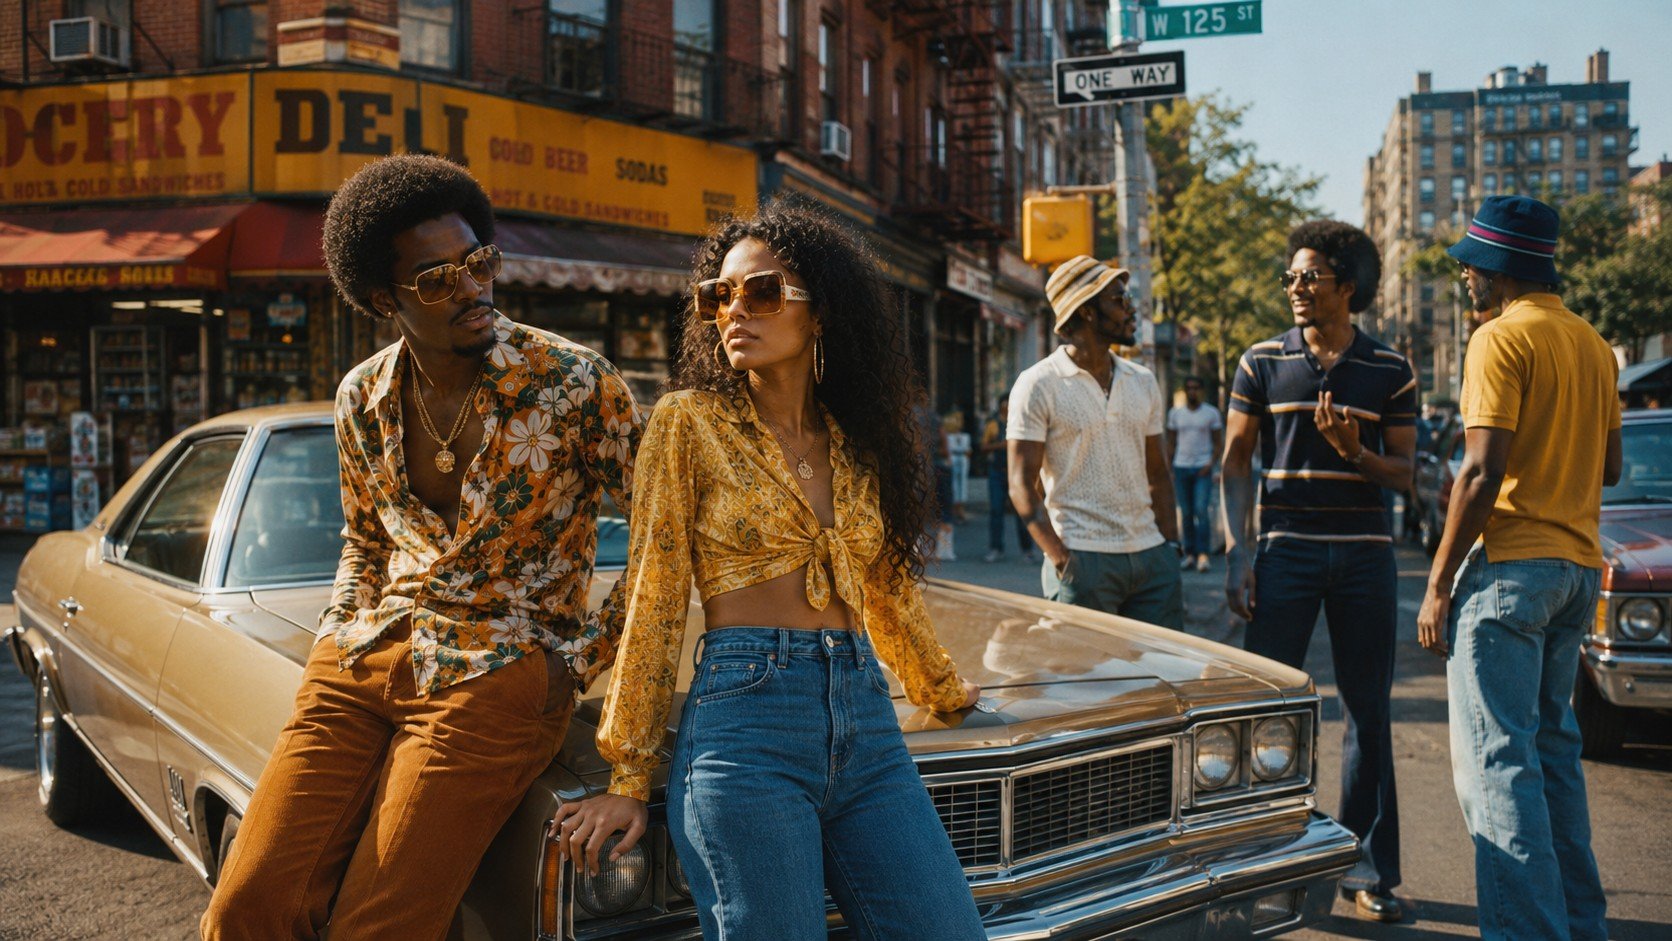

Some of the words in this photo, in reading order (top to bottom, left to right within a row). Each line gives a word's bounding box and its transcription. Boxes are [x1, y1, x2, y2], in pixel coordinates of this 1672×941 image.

[1152, 14, 1168, 36] W
[1182, 7, 1226, 34] 125
[1237, 5, 1254, 21] ST
[1075, 71, 1113, 90] ONE
[1130, 65, 1170, 85] WAY
[275, 89, 468, 167] DELI
[544, 146, 589, 175] BEER
[615, 157, 668, 186] SODAS
